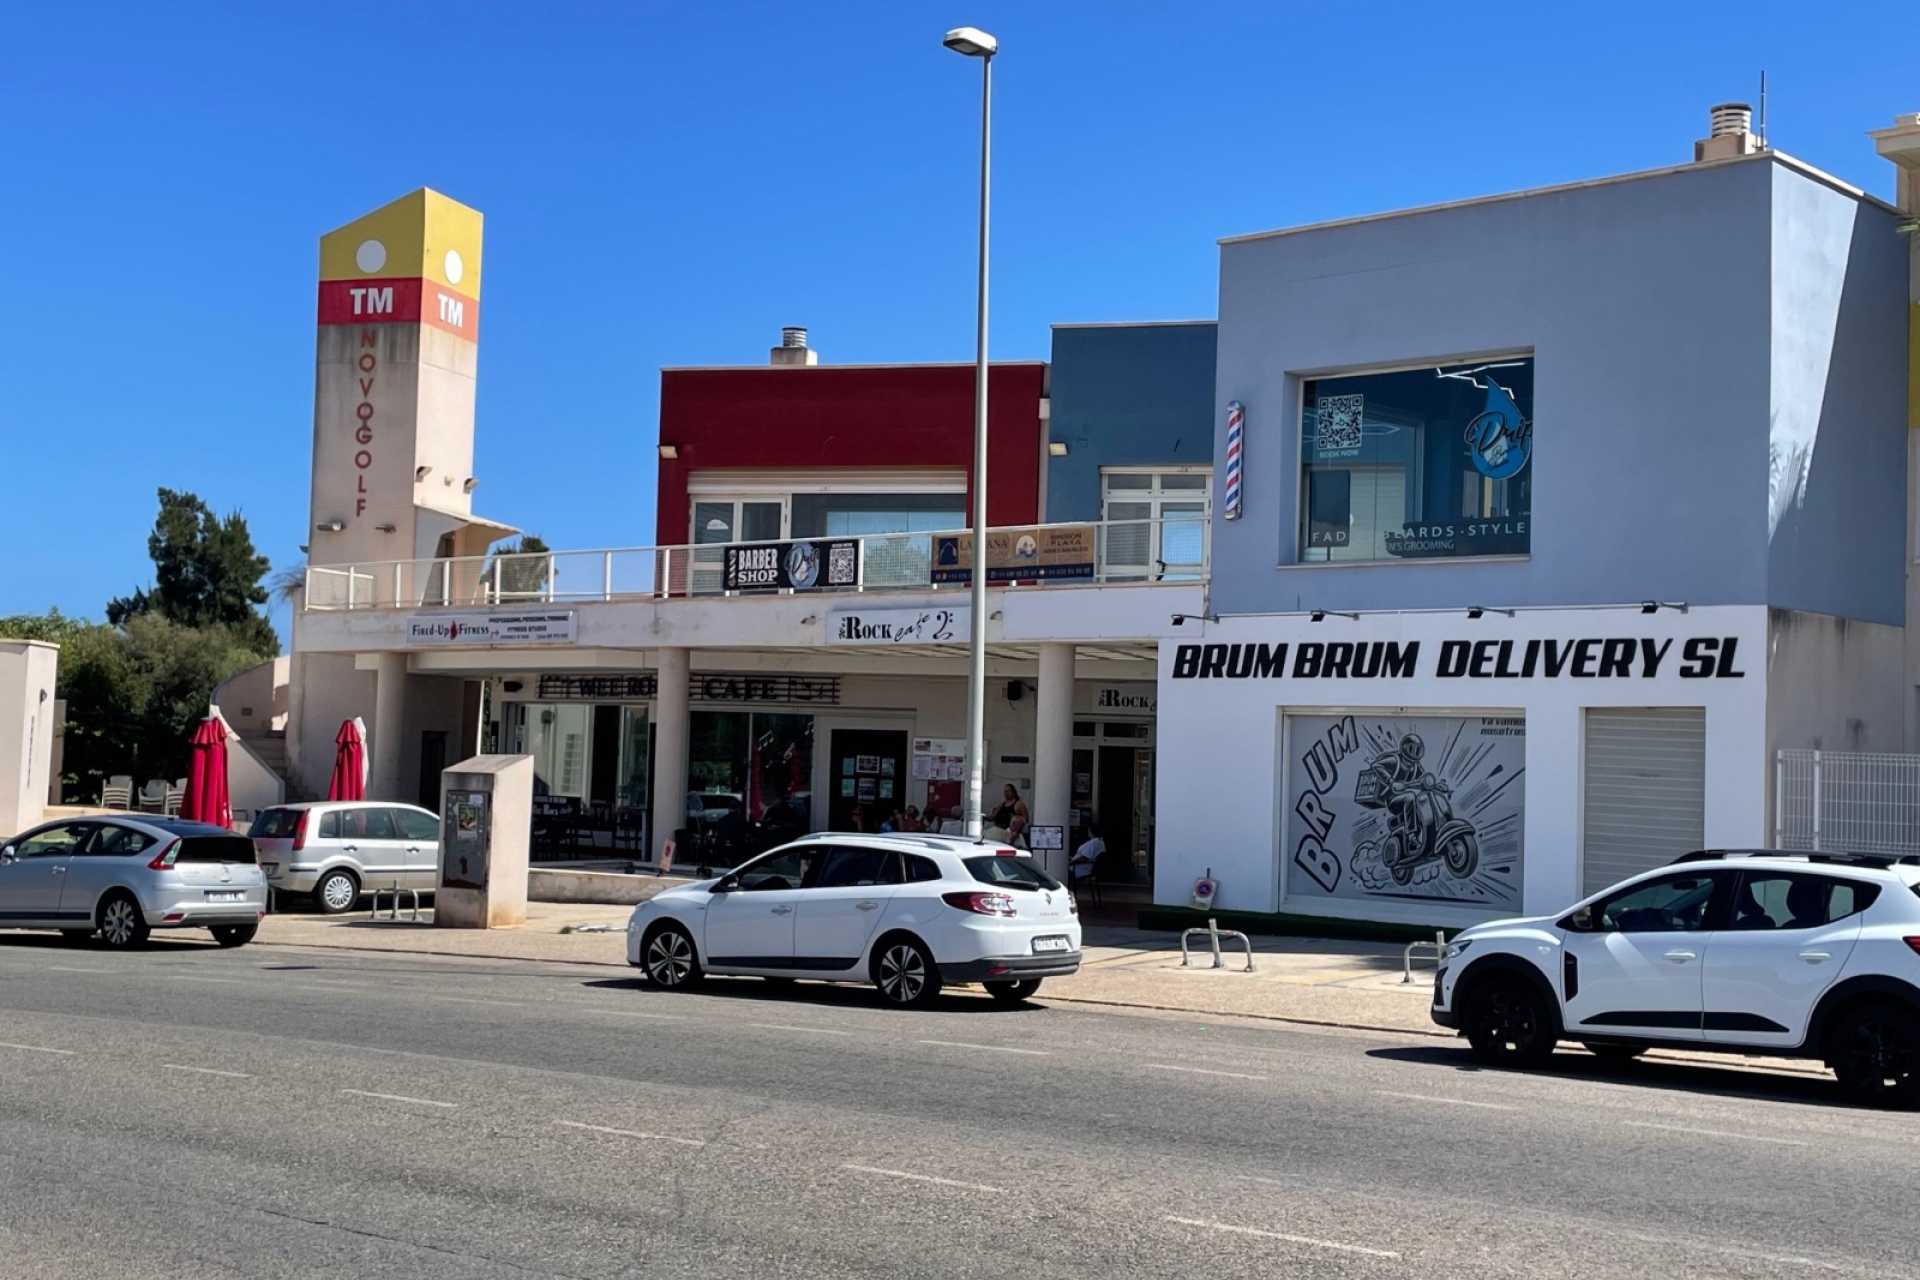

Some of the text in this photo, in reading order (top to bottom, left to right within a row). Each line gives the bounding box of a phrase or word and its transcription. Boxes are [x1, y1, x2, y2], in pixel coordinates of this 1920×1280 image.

[350, 286, 394, 315] TM
[437, 293, 463, 328] TM
[354, 329, 377, 517] NOVOGOLF
[1341, 449, 1359, 458] NOW
[1468, 522, 1525, 536] STYLE
[1404, 540, 1454, 551] GROOMING
[738, 548, 778, 570] BARBER
[738, 570, 778, 582] SHOP
[1172, 637, 1745, 679] BRUM BRUM DELIVERY SL
[1294, 715, 1360, 893] BRUM
